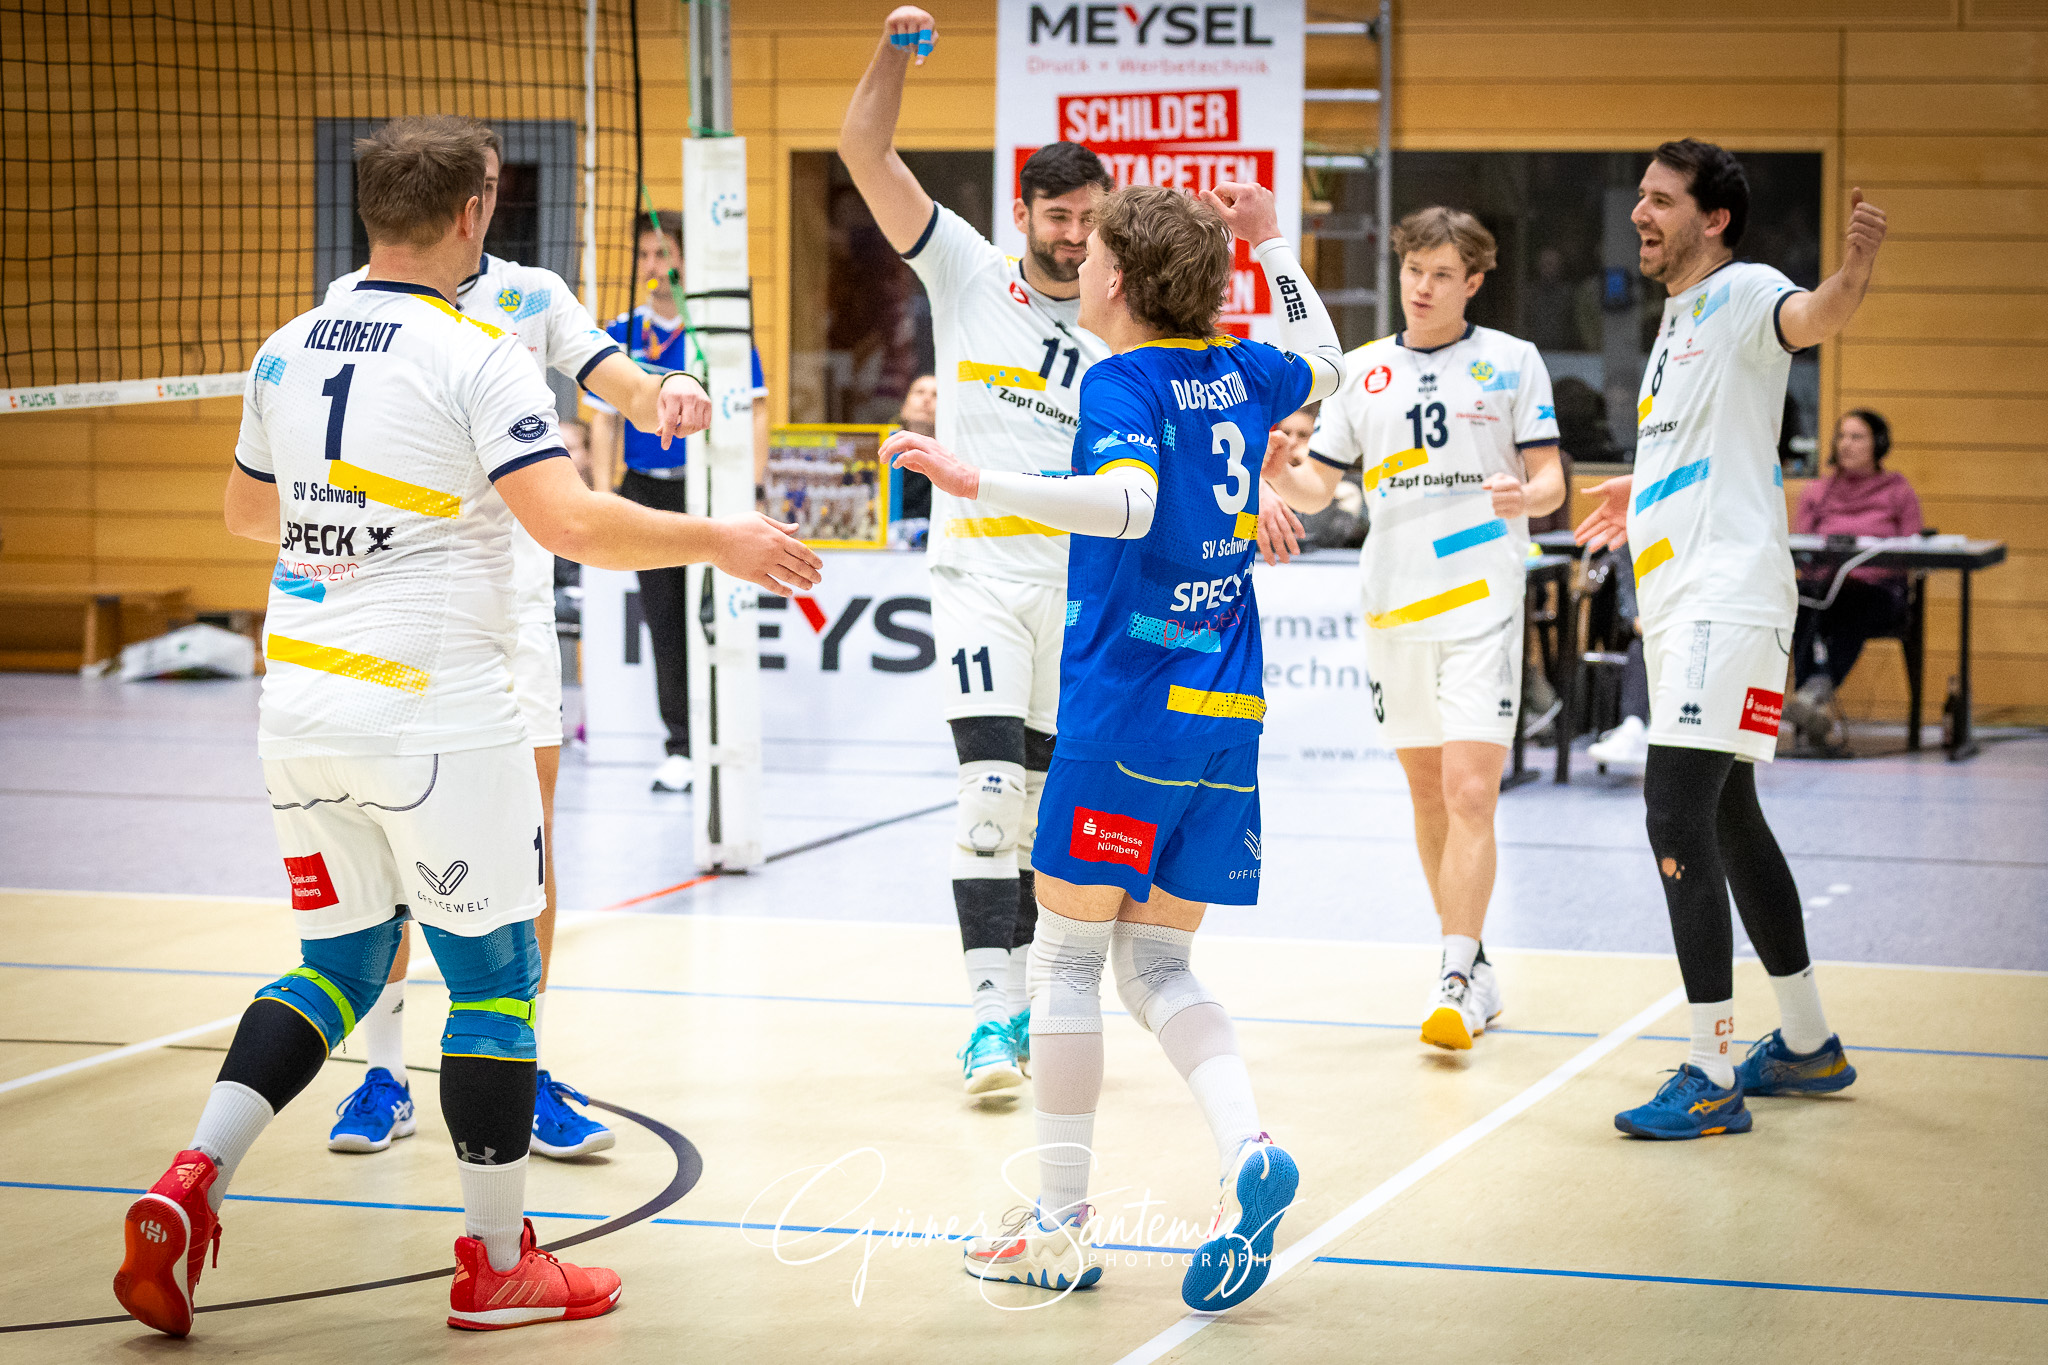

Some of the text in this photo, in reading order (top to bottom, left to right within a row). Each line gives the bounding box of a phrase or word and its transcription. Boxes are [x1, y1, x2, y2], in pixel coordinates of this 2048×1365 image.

[1029, 5, 1274, 45] MEYSEL
[1065, 94, 1229, 142] SCHILDER
[304, 319, 403, 352] KLEMENT
[1038, 337, 1080, 389] 11
[1652, 348, 1668, 397] 8
[321, 363, 356, 460] 1
[998, 387, 1032, 408] Zapf
[1406, 402, 1449, 449] 13
[1210, 421, 1251, 515] 3
[1389, 471, 1484, 490] Zapf Daigfuss
[293, 481, 366, 509] SV Schwaig
[281, 520, 358, 557] SPECK
[1202, 537, 1249, 559] SV Schwa
[951, 646, 994, 694] 11
[533, 825, 544, 886] 1
[1097, 842, 1140, 859] Nürnberg
[1099, 829, 1143, 847] Sparkasse
[1229, 869, 1261, 880] OFFICE
[182, 1162, 206, 1189] adidas
